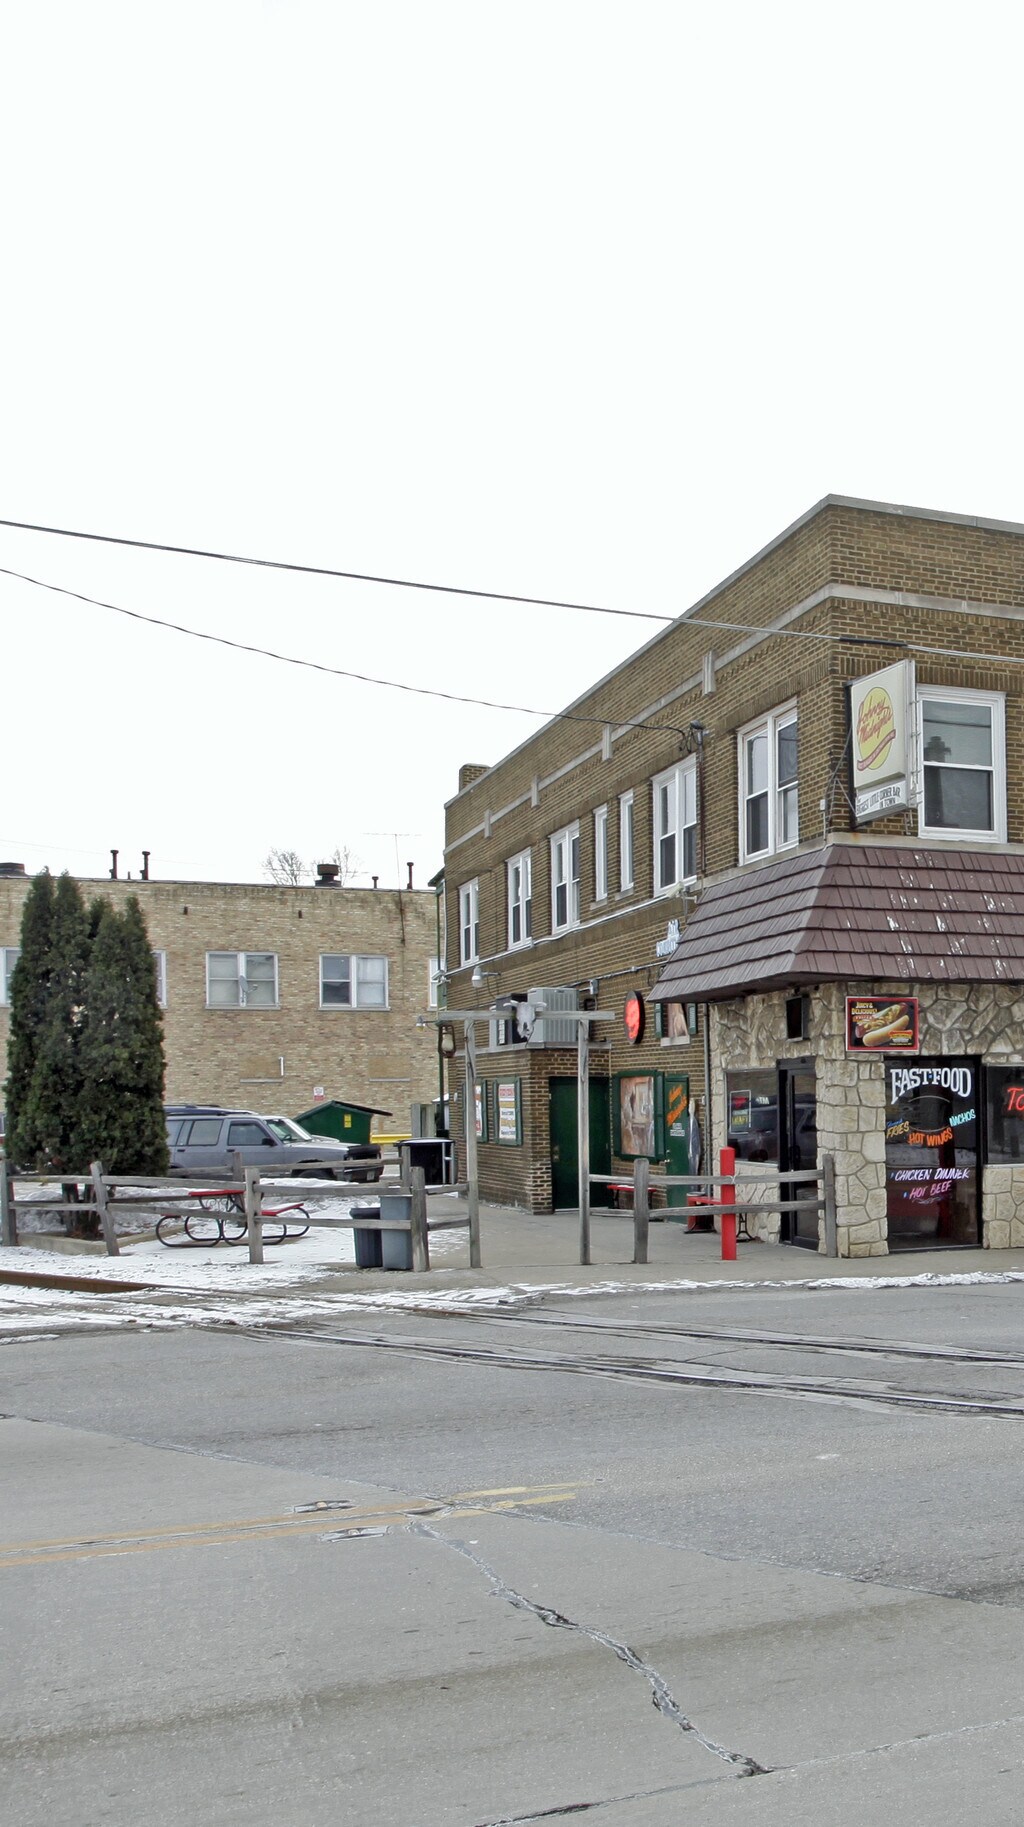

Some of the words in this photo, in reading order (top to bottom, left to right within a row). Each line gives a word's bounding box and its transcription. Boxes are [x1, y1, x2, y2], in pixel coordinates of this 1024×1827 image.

[931, 1067, 972, 1098] FOOD
[949, 1108, 976, 1127] NACHOS
[886, 1121, 910, 1139] FRIES
[907, 1132, 926, 1146] HOT
[926, 1126, 953, 1147] WINGS
[894, 1169, 933, 1181] CHICKEN
[909, 1186, 928, 1200] HOT
[930, 1180, 953, 1196] BEEF
